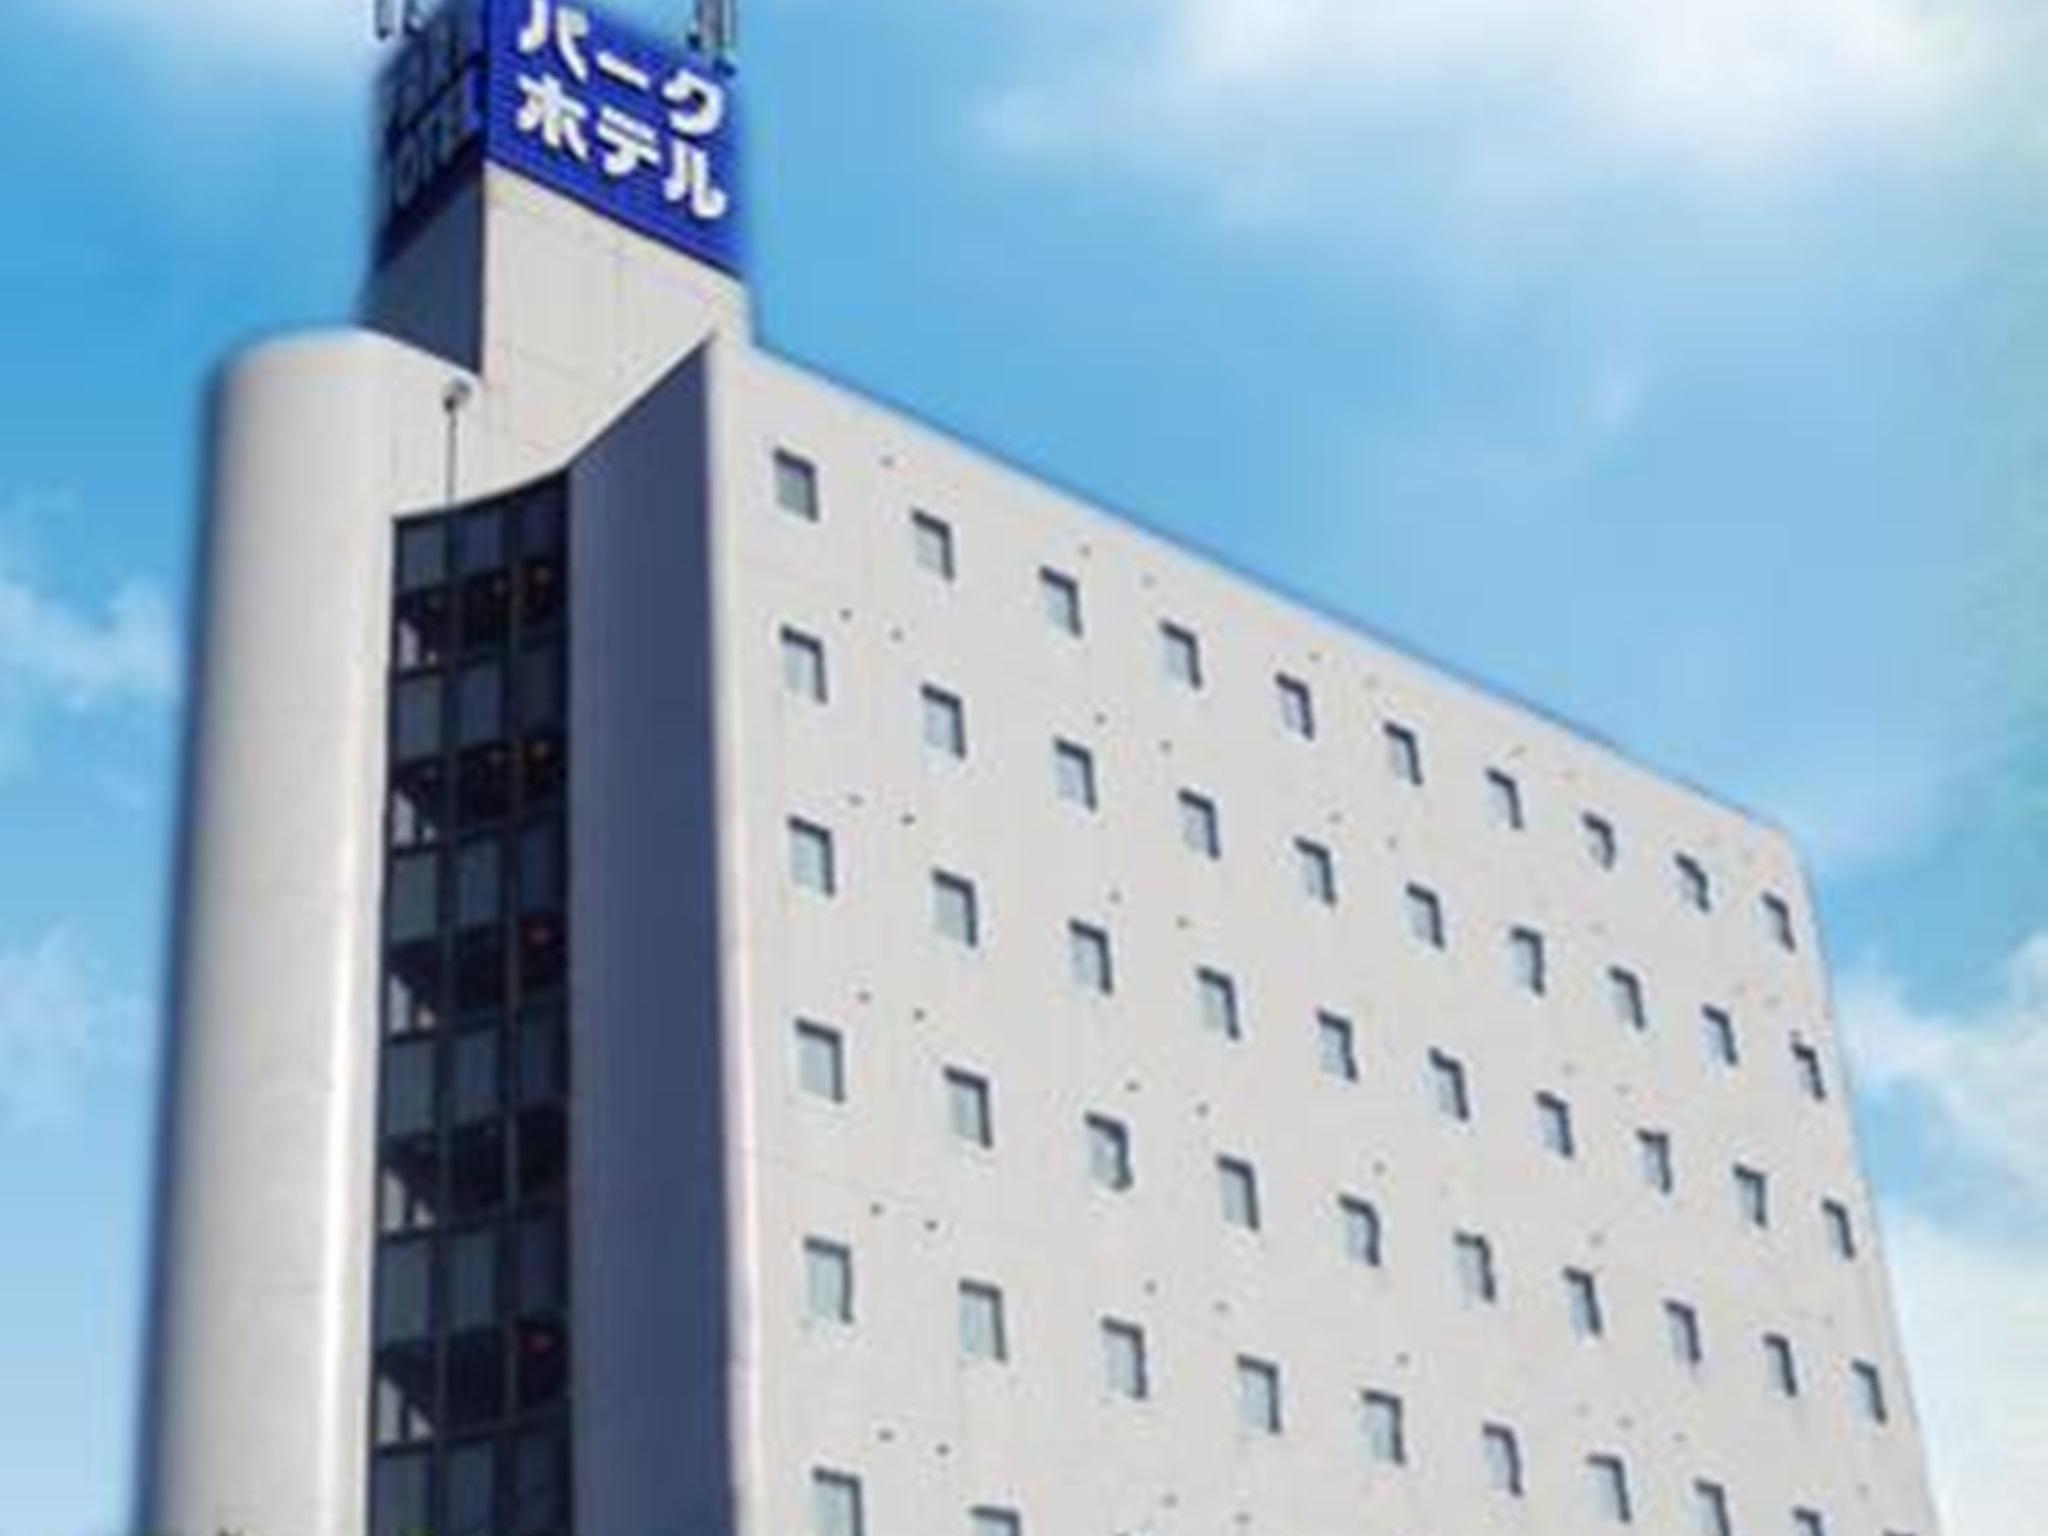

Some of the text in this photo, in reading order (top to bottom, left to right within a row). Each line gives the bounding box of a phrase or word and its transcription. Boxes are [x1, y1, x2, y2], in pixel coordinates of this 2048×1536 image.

[518, 0, 722, 135] パーク
[516, 73, 727, 219] ホテル
